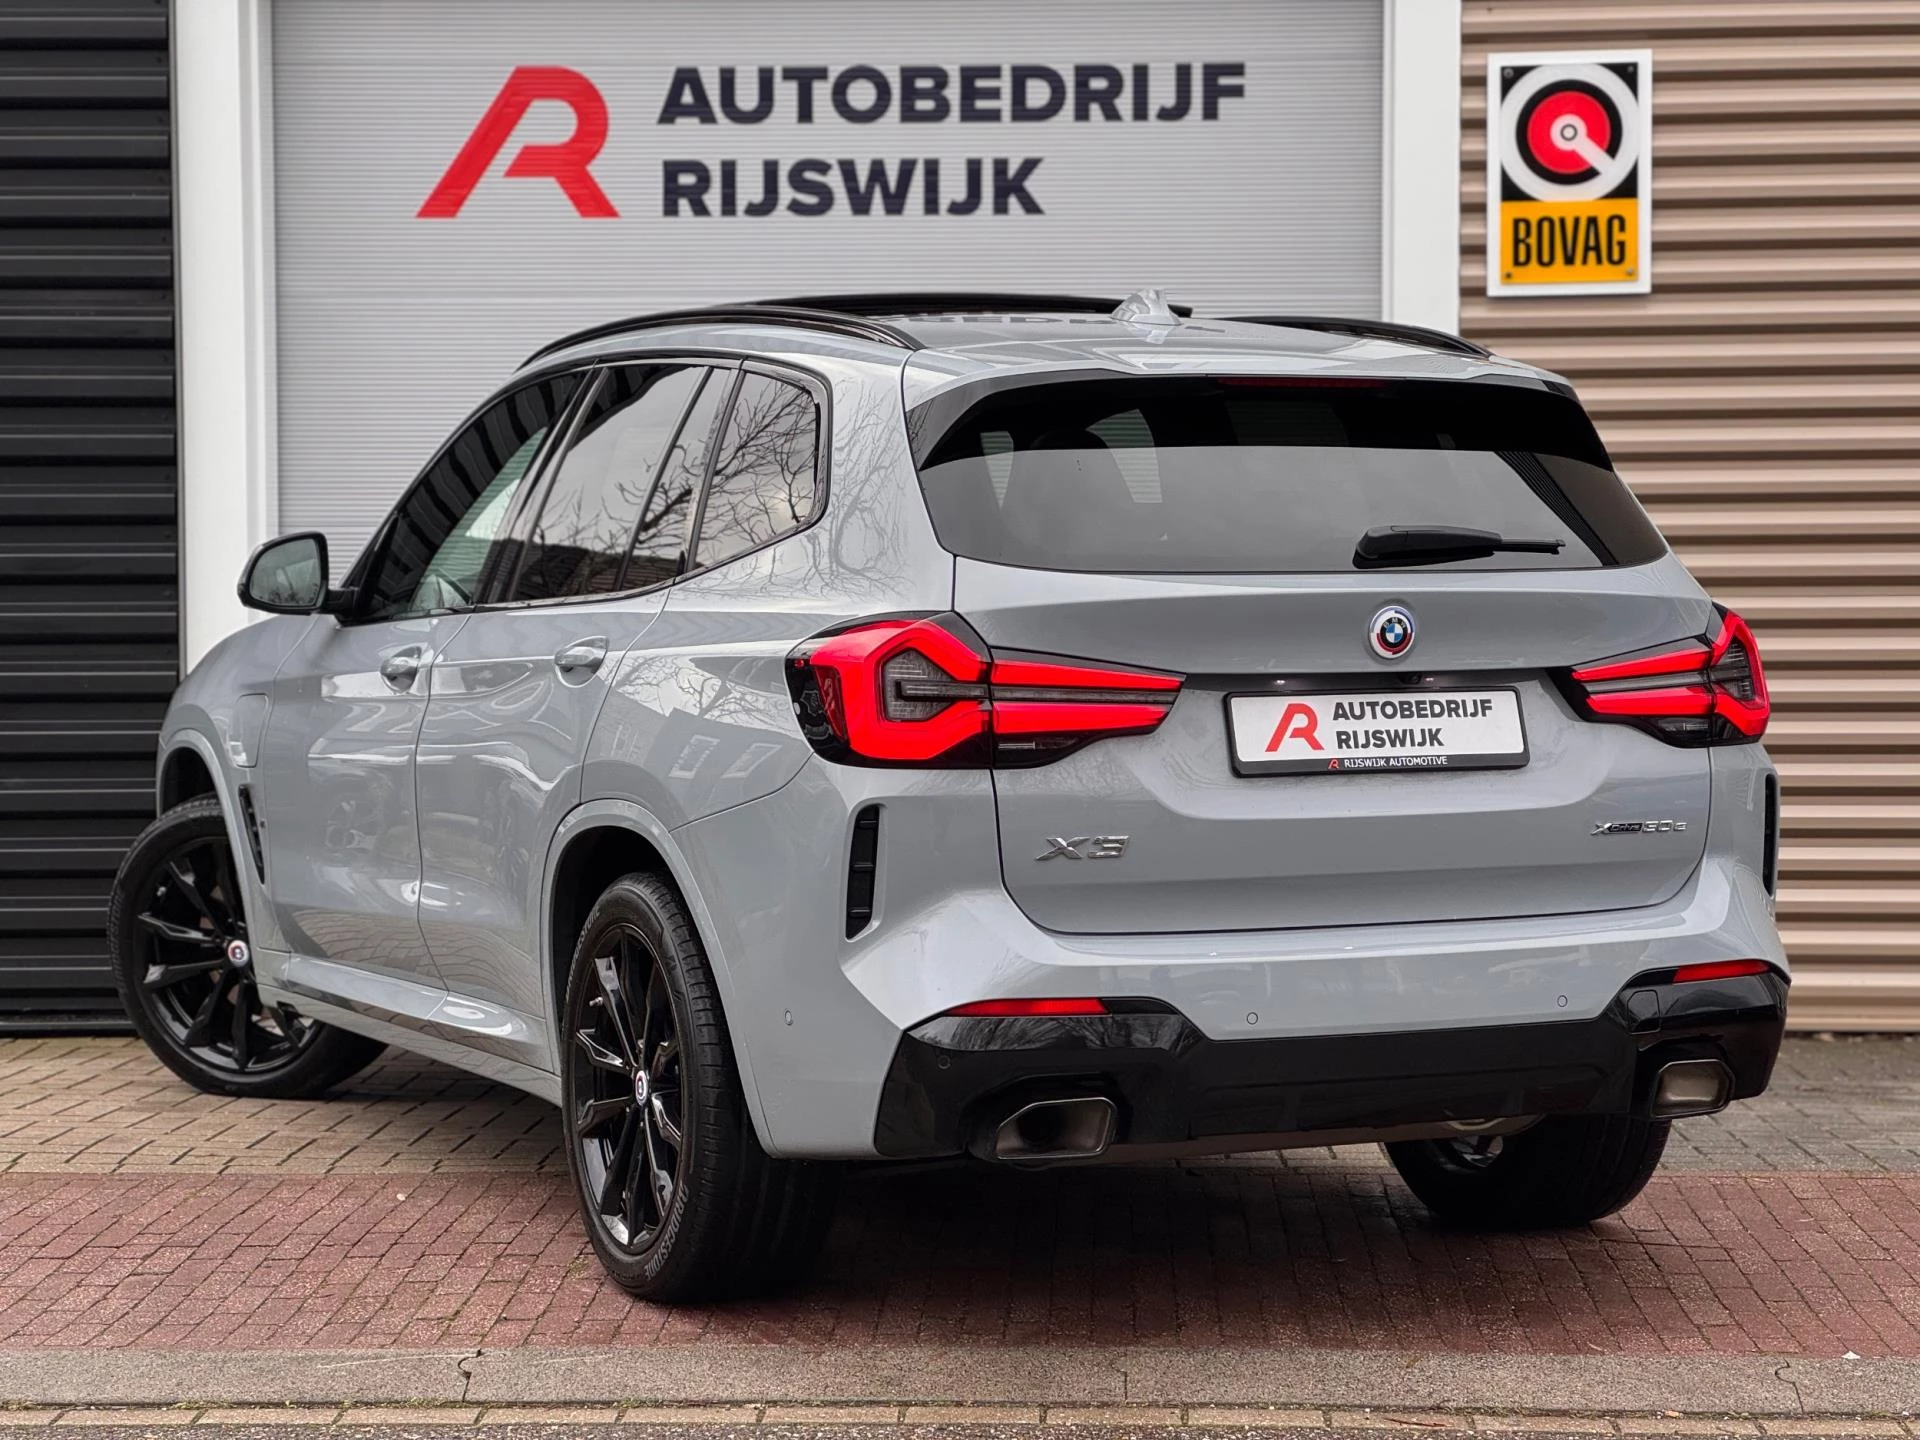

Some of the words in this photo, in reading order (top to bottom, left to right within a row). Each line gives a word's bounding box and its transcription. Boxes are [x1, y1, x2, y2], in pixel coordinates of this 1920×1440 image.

[657, 62, 1245, 125] AUTOBEDRIJF
[662, 157, 1045, 217] RIJSWIJK
[1512, 214, 1627, 268] BOVAG
[1332, 698, 1493, 721] AUTOBEDRIJF
[1336, 727, 1444, 750] RIJSWIJK
[1344, 758, 1387, 768] RIJSWIJK
[1389, 756, 1448, 768] AUTOMOTIVE
[1034, 835, 1130, 861] X3
